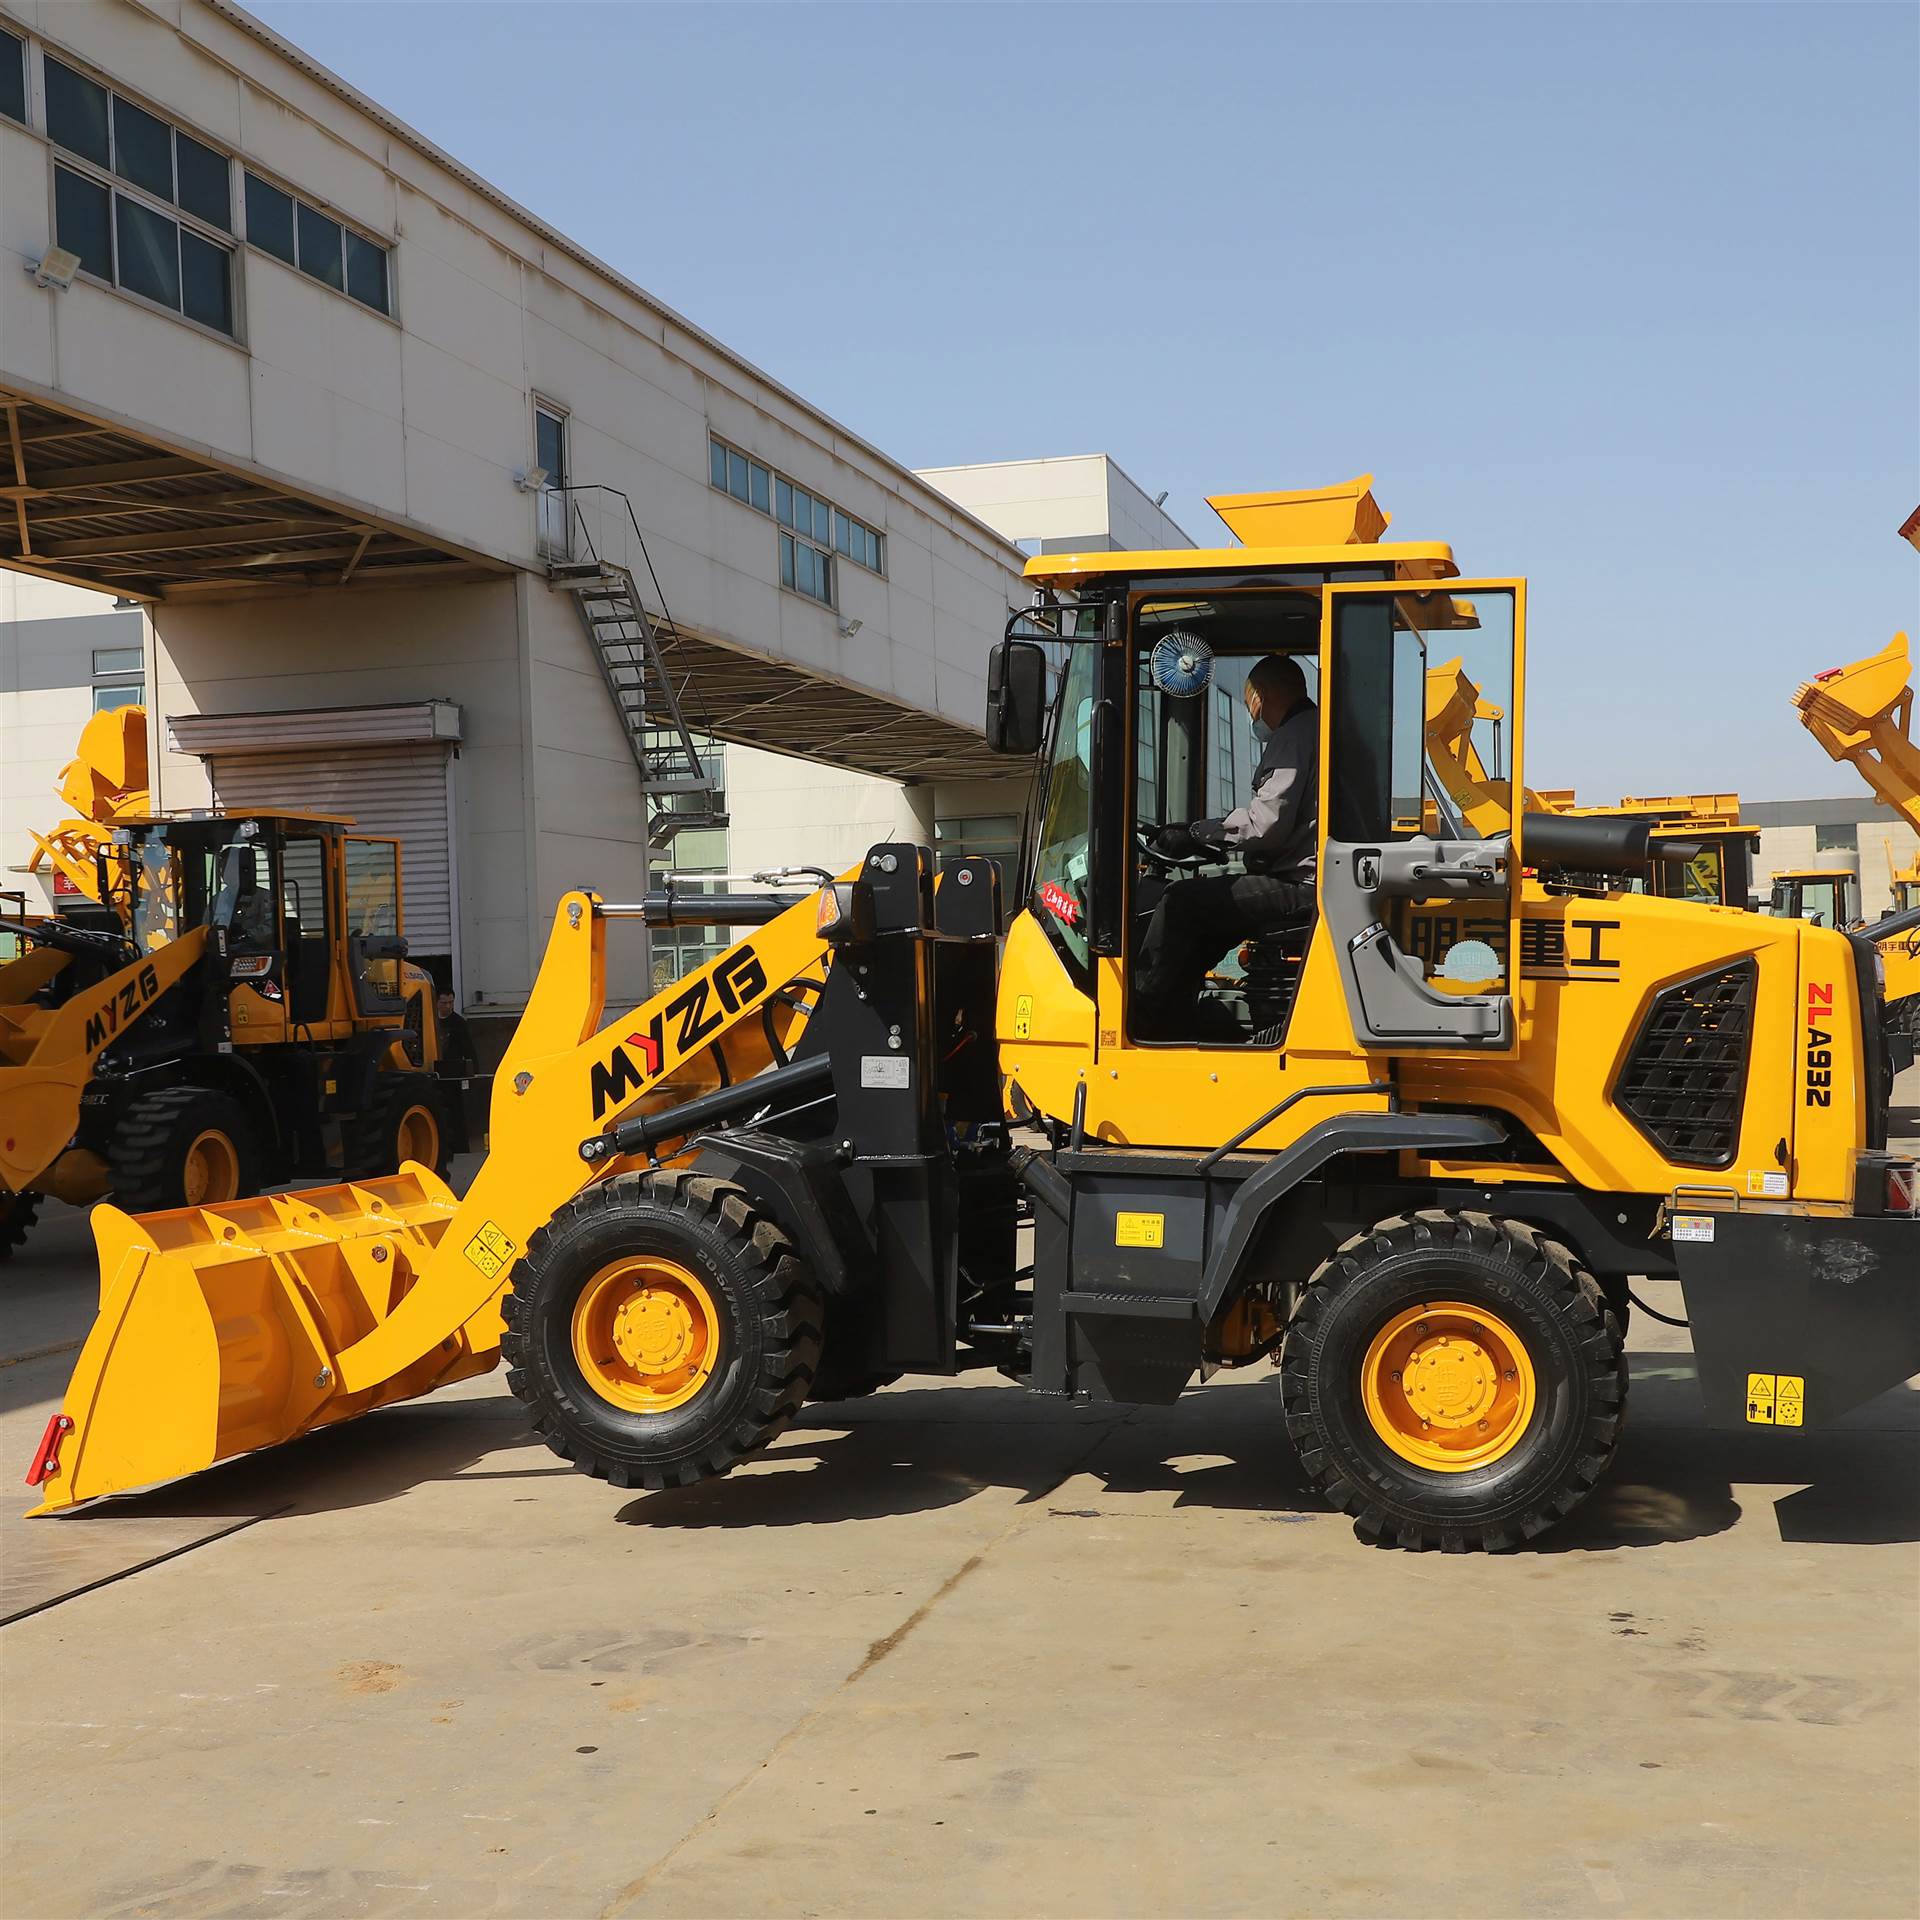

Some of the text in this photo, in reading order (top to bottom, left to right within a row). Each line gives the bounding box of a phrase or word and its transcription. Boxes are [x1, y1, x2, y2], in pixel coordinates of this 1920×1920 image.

[86, 963, 159, 1055] MYZG
[591, 944, 767, 1122] MYZG
[1806, 983, 1832, 1107] ZLA932
